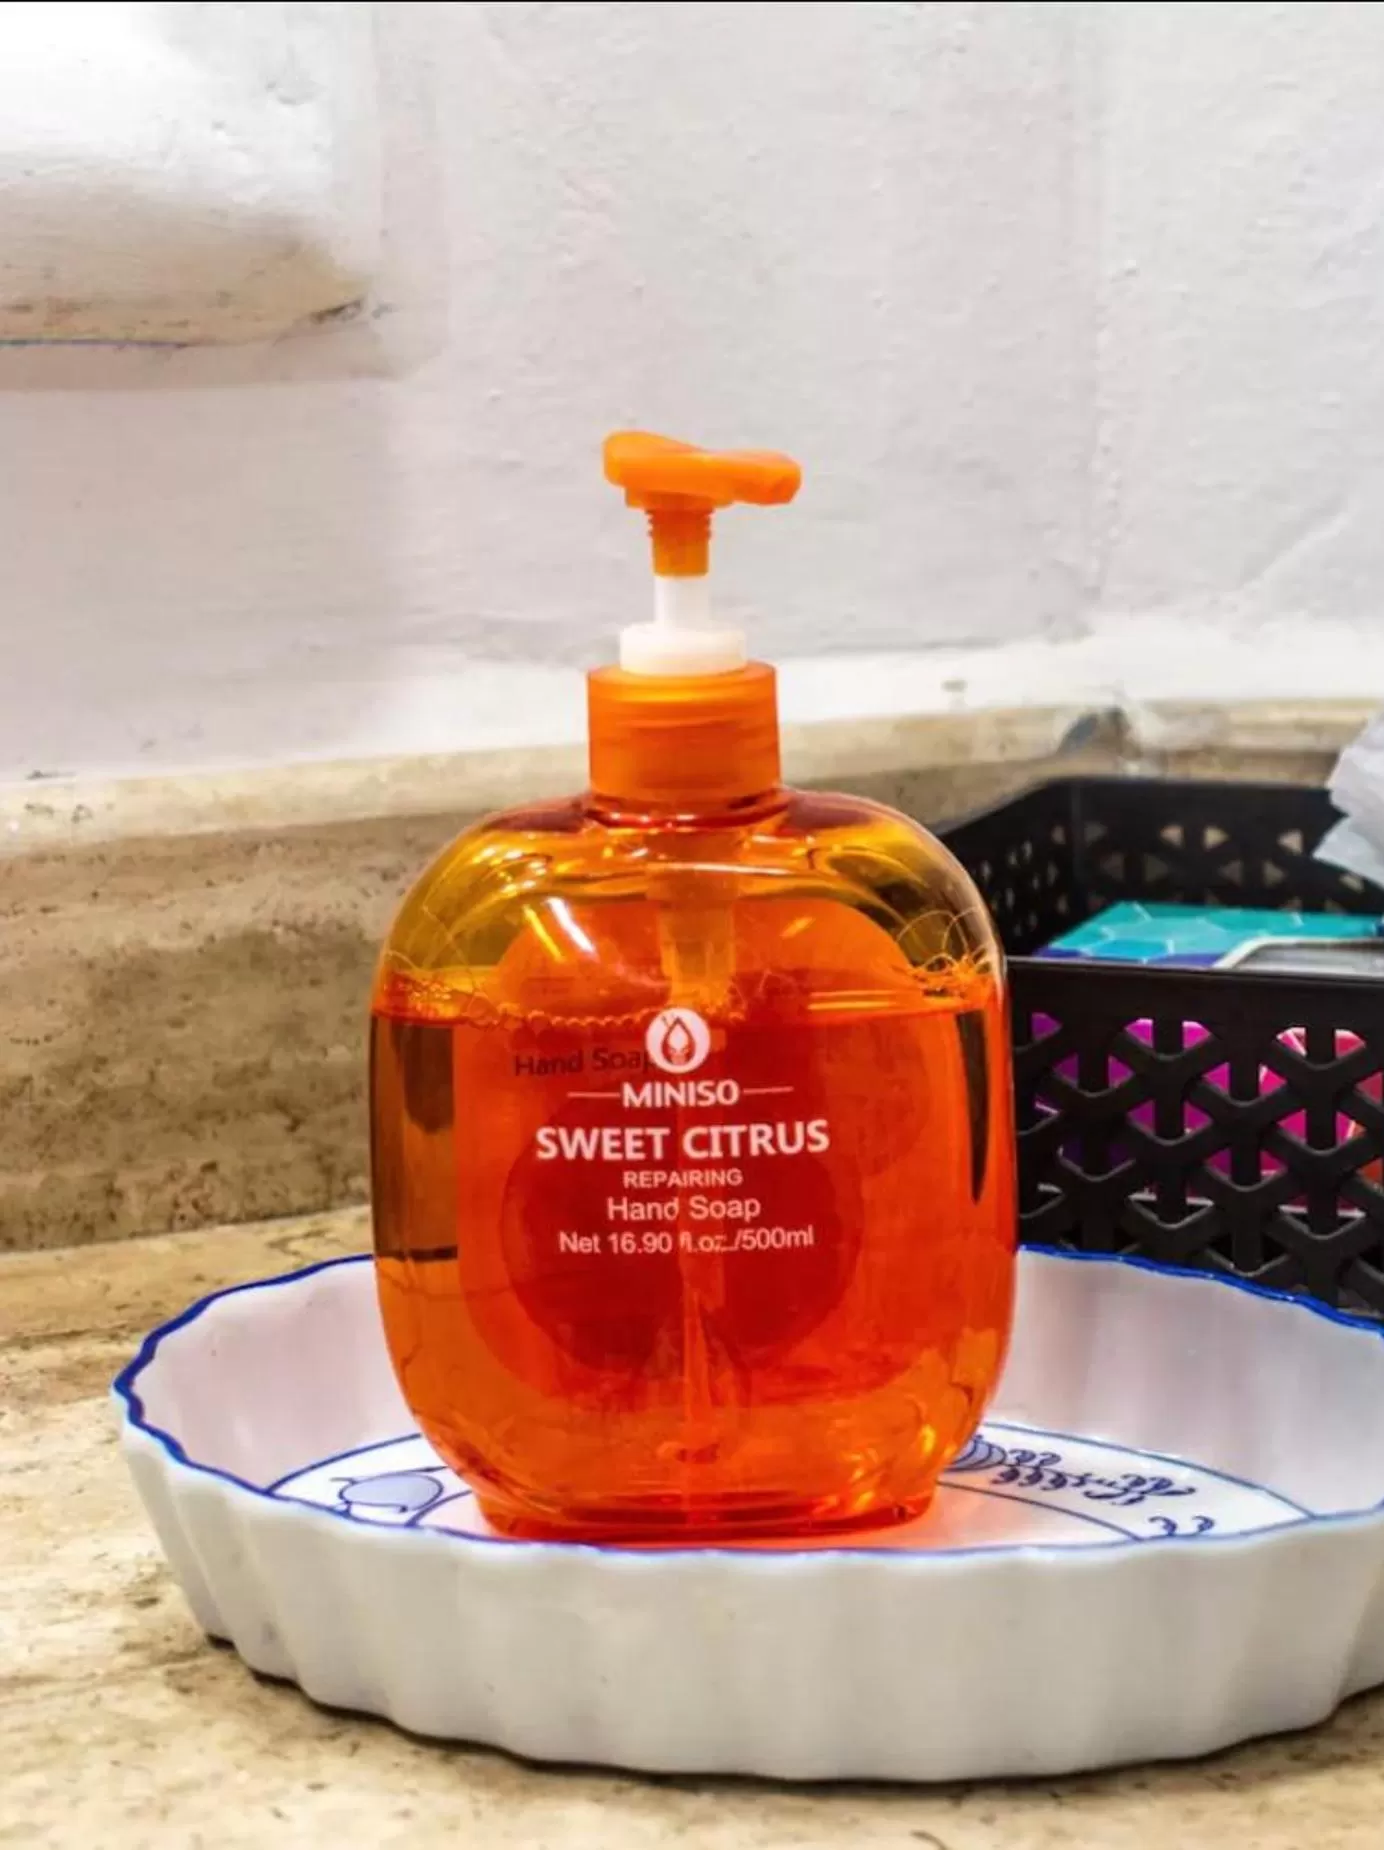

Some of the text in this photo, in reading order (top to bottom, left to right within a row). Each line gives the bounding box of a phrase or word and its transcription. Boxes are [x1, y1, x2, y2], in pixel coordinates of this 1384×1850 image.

[514, 1049, 585, 1076] Hand
[622, 1080, 740, 1108] MINISO
[535, 1119, 830, 1161] SWEET CITRUS
[623, 1168, 743, 1189] REPAIRING
[607, 1195, 761, 1222] Hand Soap
[559, 1232, 600, 1254] Net
[609, 1231, 672, 1254] 16.90
